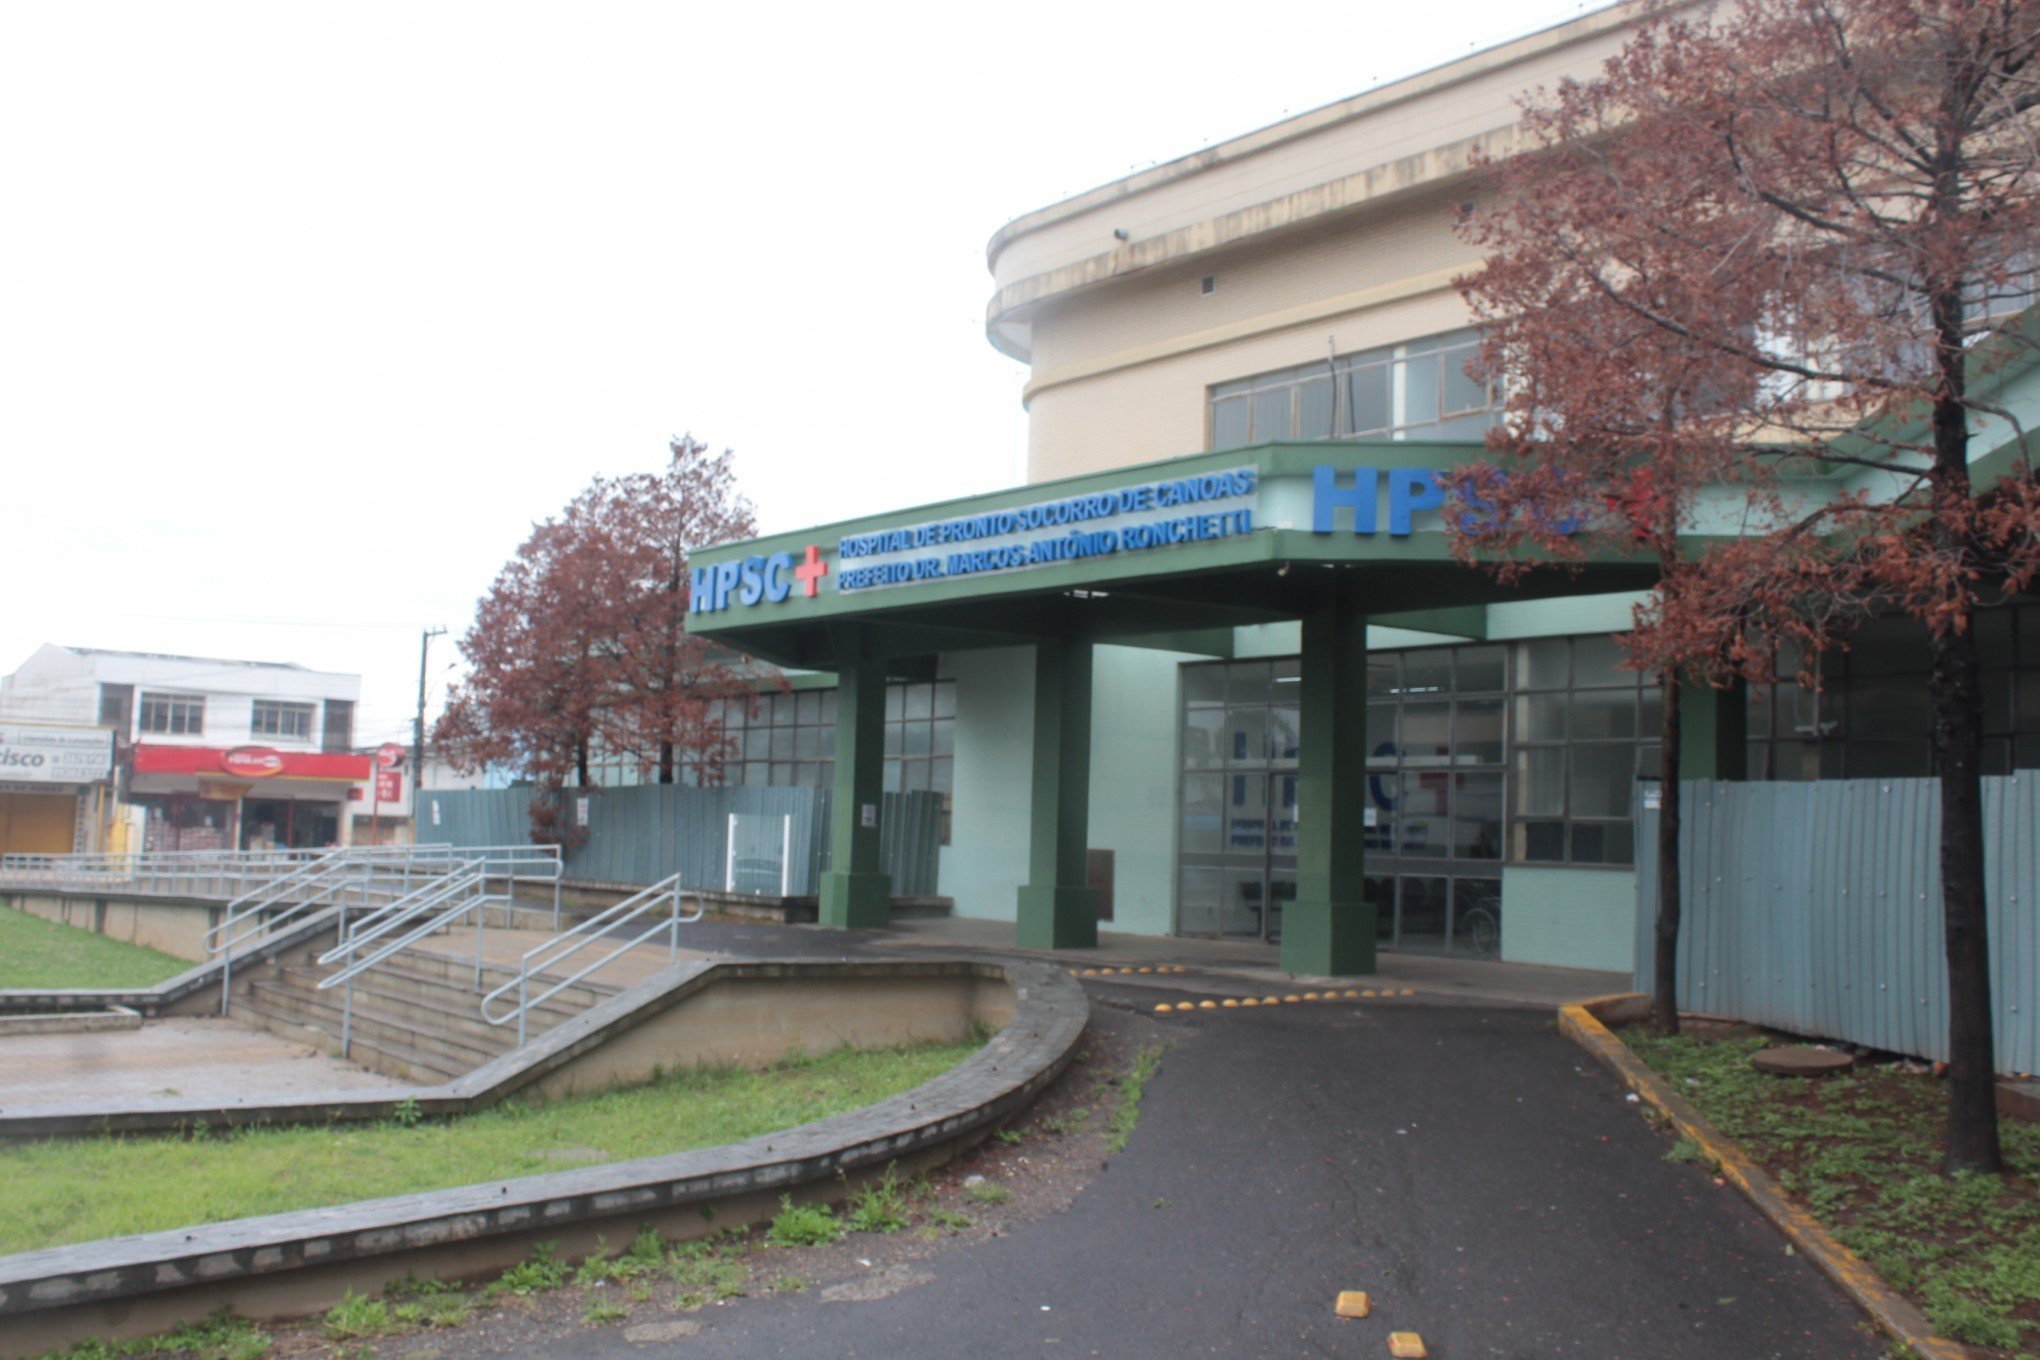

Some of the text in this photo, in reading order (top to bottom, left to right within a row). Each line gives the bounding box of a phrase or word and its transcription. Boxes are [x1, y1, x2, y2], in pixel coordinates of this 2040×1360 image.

[838, 469, 1256, 559] HOSPITAL DE PRONTO SOCORRO DE CANOAS
[838, 509, 1253, 590] PREFEITO DR. MARCOS ANTÔNIO RONCHETTI
[690, 551, 793, 614] HPSC
